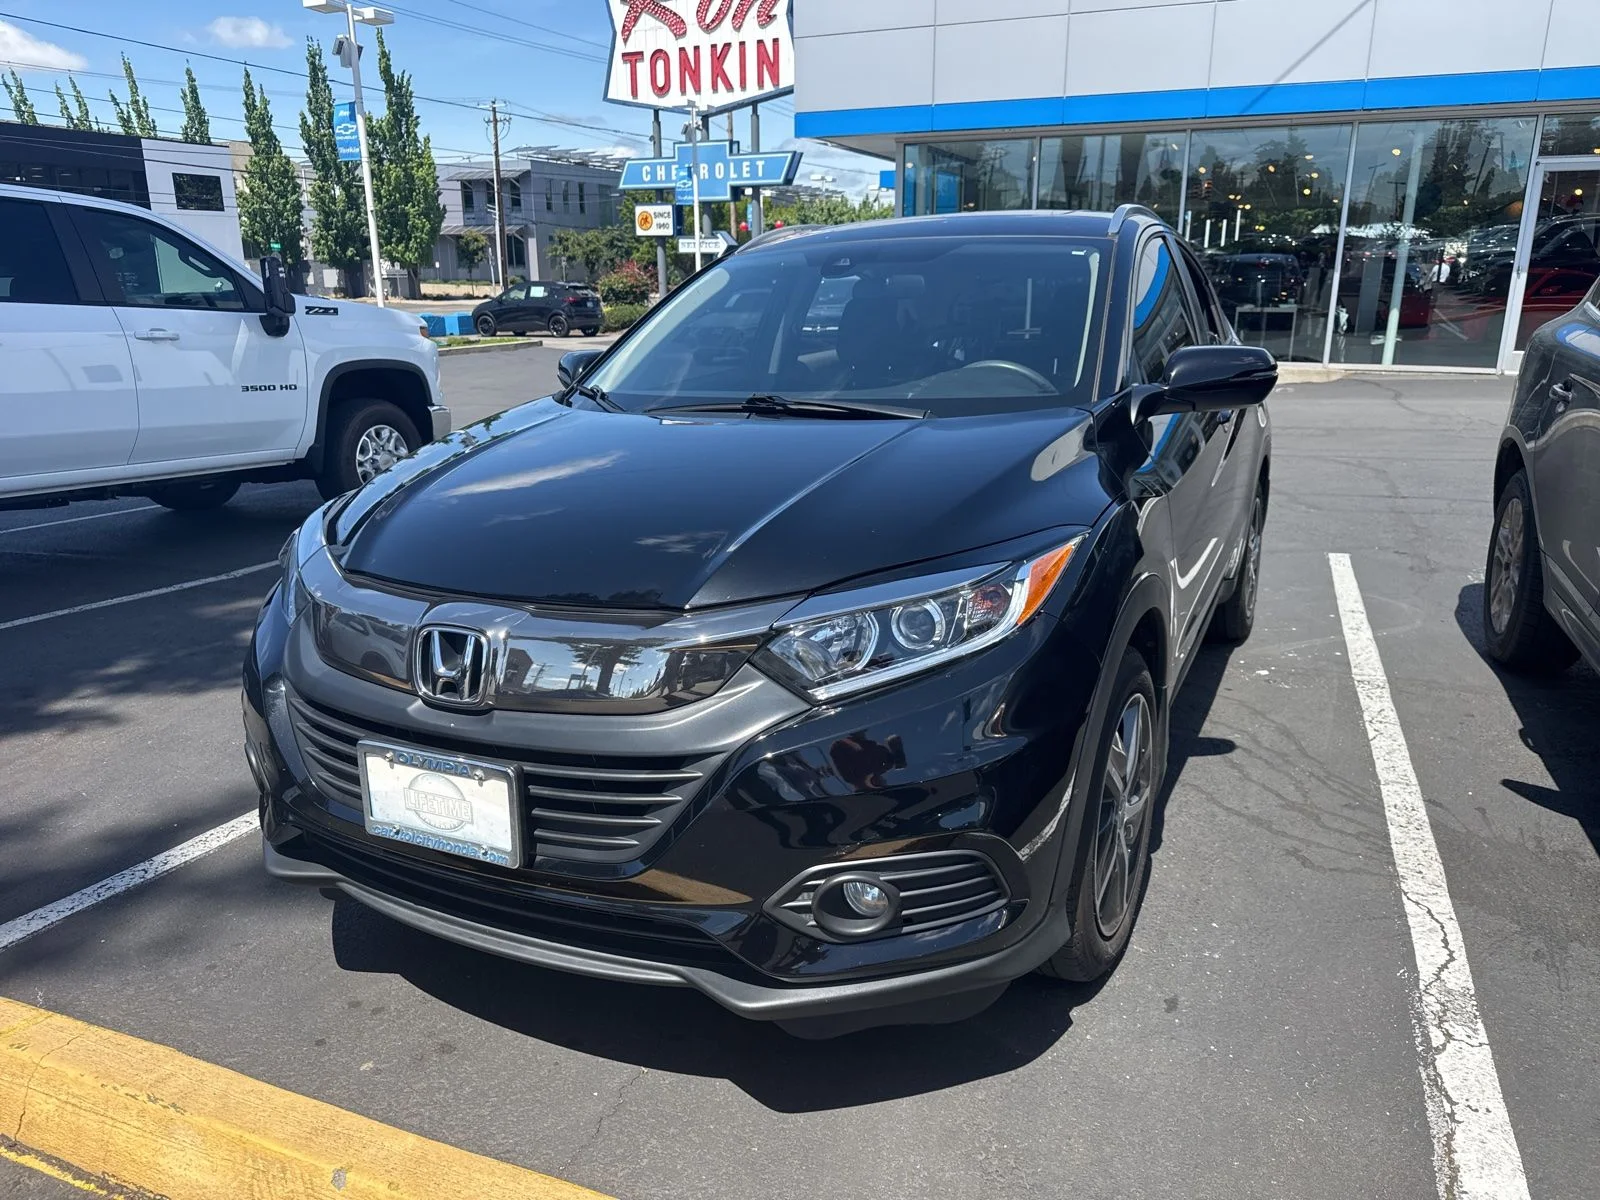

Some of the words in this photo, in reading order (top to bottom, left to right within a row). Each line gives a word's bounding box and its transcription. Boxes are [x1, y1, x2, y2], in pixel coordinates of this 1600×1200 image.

[621, 37, 780, 99] TONKIN
[642, 160, 765, 182] CHEROLET
[653, 211, 672, 219] SINCE
[656, 222, 670, 230] 1960
[241, 384, 276, 392] 3500
[396, 751, 471, 777] OLYMPIA
[405, 789, 470, 820] LIFETIME
